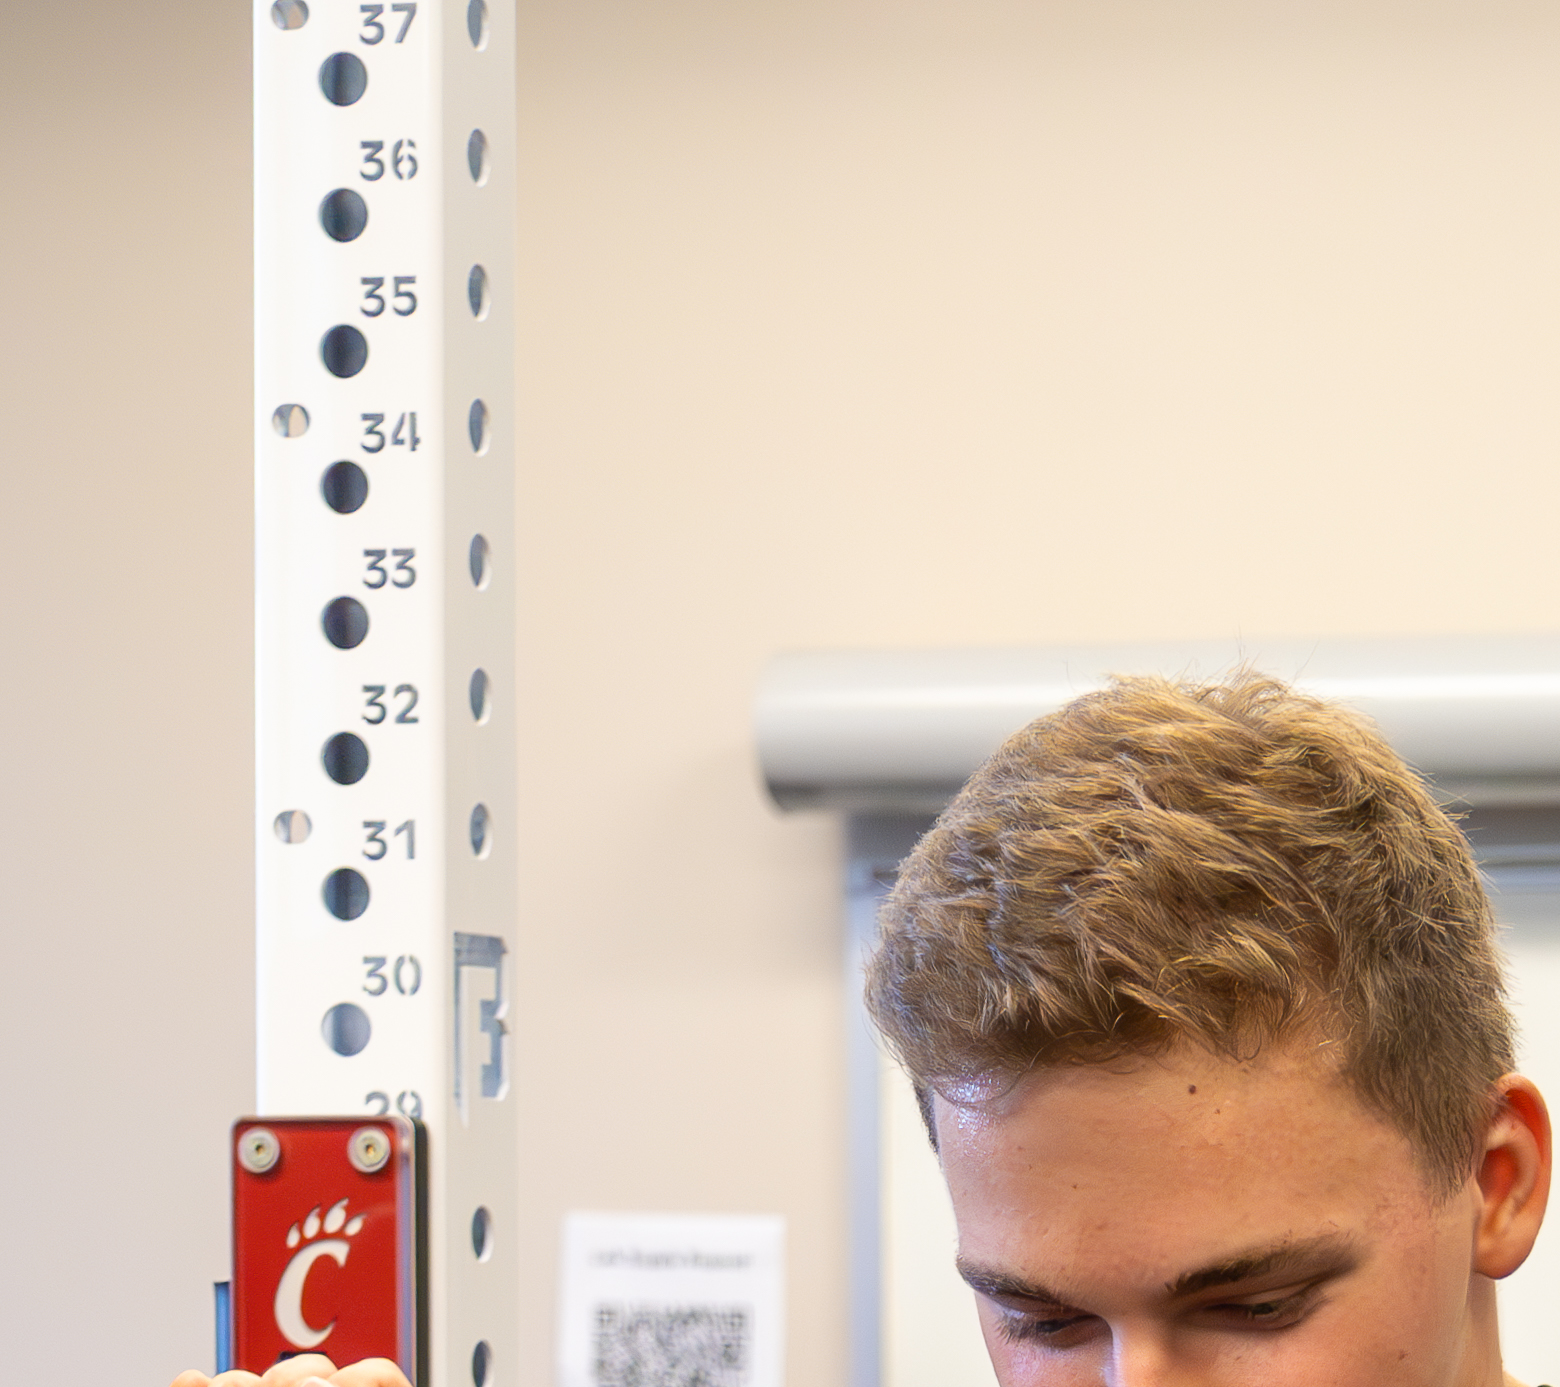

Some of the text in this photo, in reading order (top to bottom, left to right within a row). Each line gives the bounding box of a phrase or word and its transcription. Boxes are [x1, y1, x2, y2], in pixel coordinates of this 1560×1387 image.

[358, 1, 418, 47] 37
[359, 138, 419, 183] 36
[359, 275, 419, 319] 35
[359, 411, 422, 455] 34
[361, 547, 418, 591] 33
[360, 682, 420, 726] 32
[361, 819, 416, 862] 31
[362, 954, 423, 998] 30
[274, 1237, 351, 1349] C
